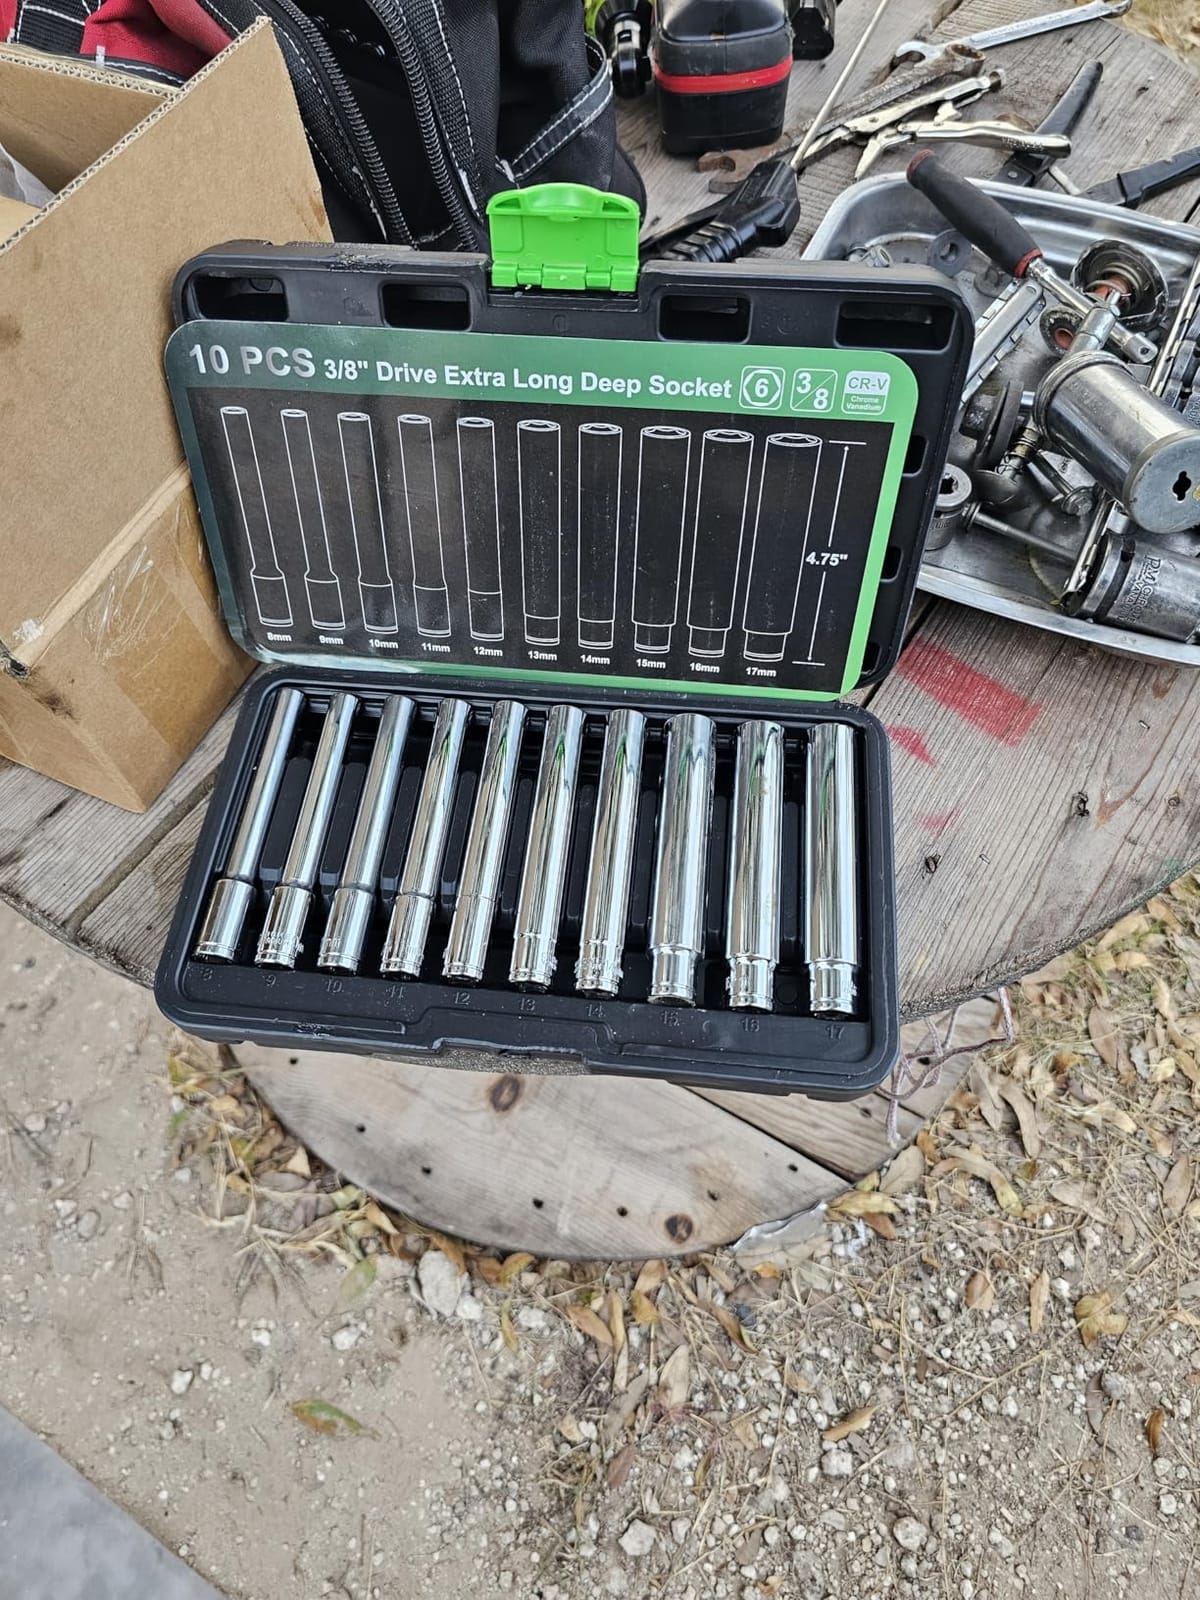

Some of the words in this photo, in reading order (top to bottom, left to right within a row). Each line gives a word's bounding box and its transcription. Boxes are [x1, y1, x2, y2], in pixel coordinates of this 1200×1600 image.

[189, 344, 229, 375] 10
[240, 346, 316, 378] PCS
[324, 359, 368, 380] 3/8"
[376, 361, 437, 385] Drive
[445, 365, 506, 388] Extra
[513, 368, 573, 395] Long
[580, 372, 641, 397] Deep
[649, 374, 732, 399] Socket
[754, 378, 769, 398] 6
[848, 377, 888, 390] CR-V
[805, 552, 848, 566] 4.75"
[267, 632, 292, 642] 8mm
[319, 635, 344, 645] 9mm
[369, 639, 398, 649] 10mm
[421, 643, 450, 653] 11mm
[473, 646, 503, 657] 12mm
[528, 650, 557, 661] 13mm
[580, 654, 610, 665] 14mm
[636, 658, 666, 669] 15mm
[689, 662, 720, 673] 16mm
[745, 667, 776, 677] 17mm
[327, 979, 344, 993] 10
[454, 992, 472, 1005] 12
[519, 998, 535, 1012] 13
[741, 1017, 760, 1032] 16
[826, 1024, 844, 1040] 17
